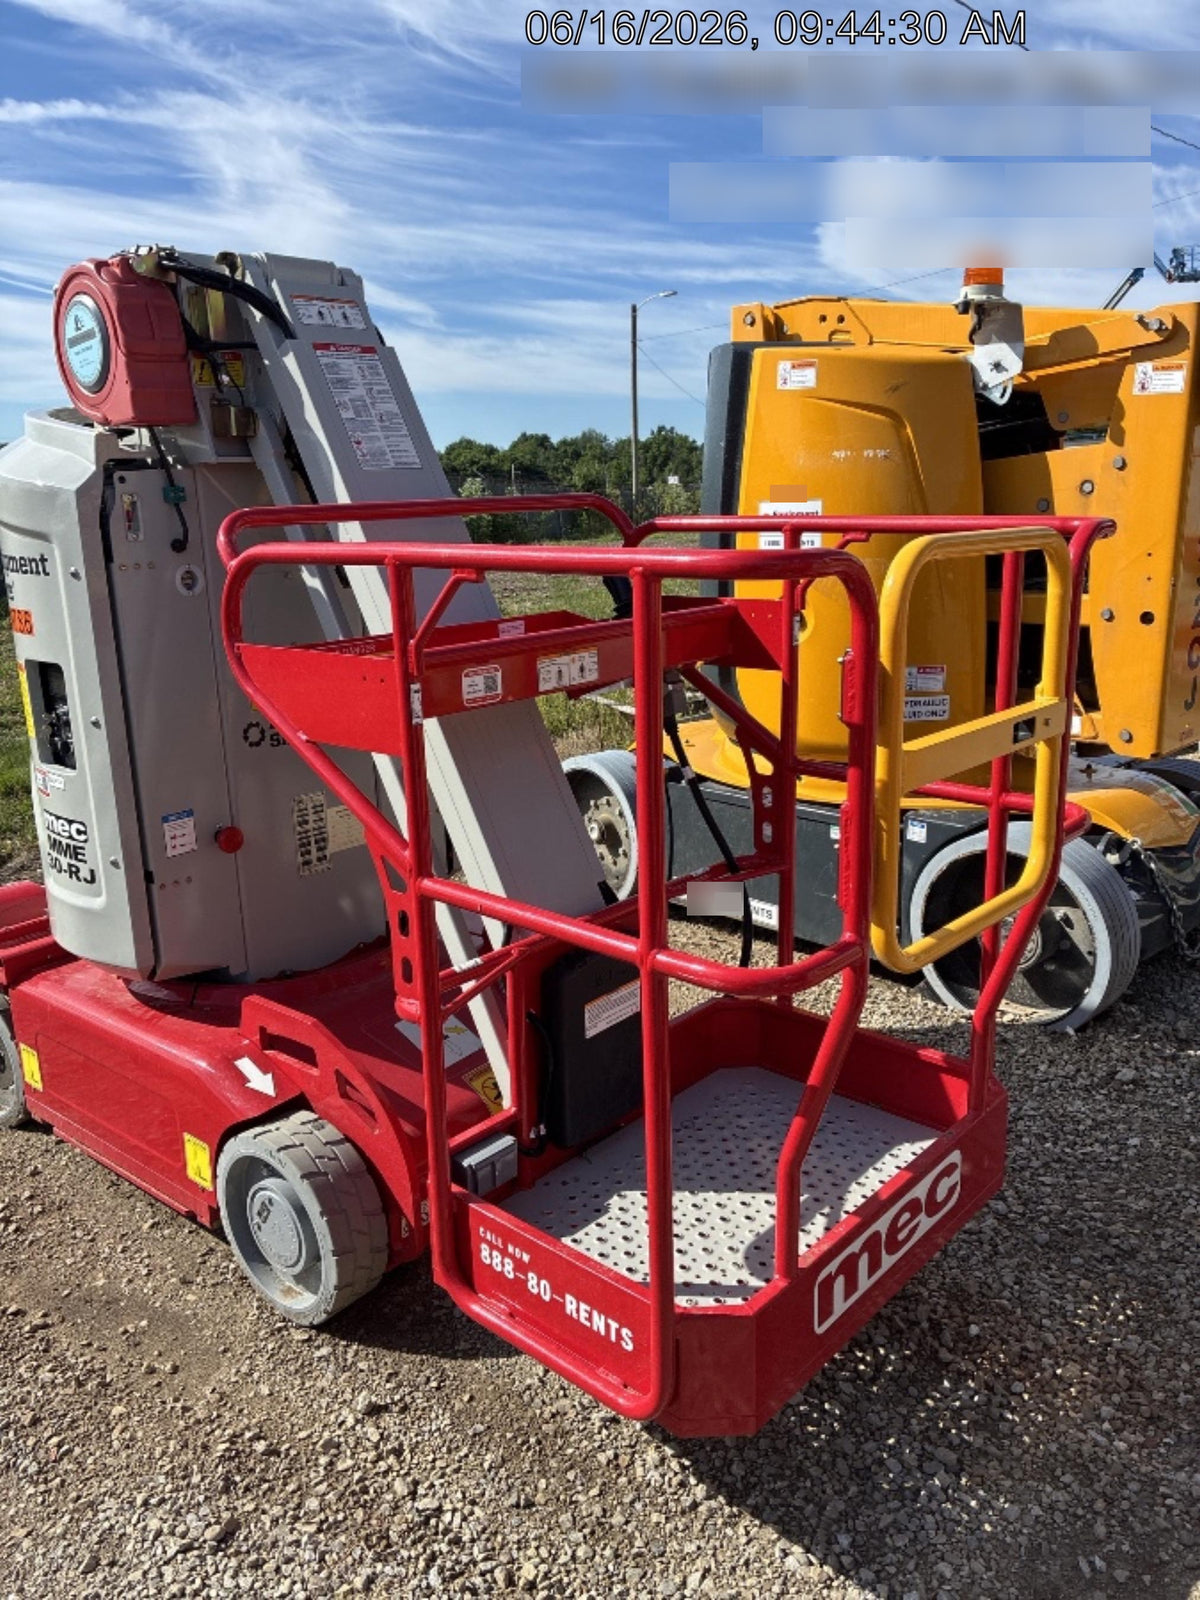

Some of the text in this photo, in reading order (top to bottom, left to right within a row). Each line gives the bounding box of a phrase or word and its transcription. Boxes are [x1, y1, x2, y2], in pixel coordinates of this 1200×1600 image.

[47, 833, 87, 864] MME
[479, 1226, 530, 1264] CALL NOW
[816, 1156, 961, 1331] mec
[480, 1242, 634, 1352] 888-80-RENTS
